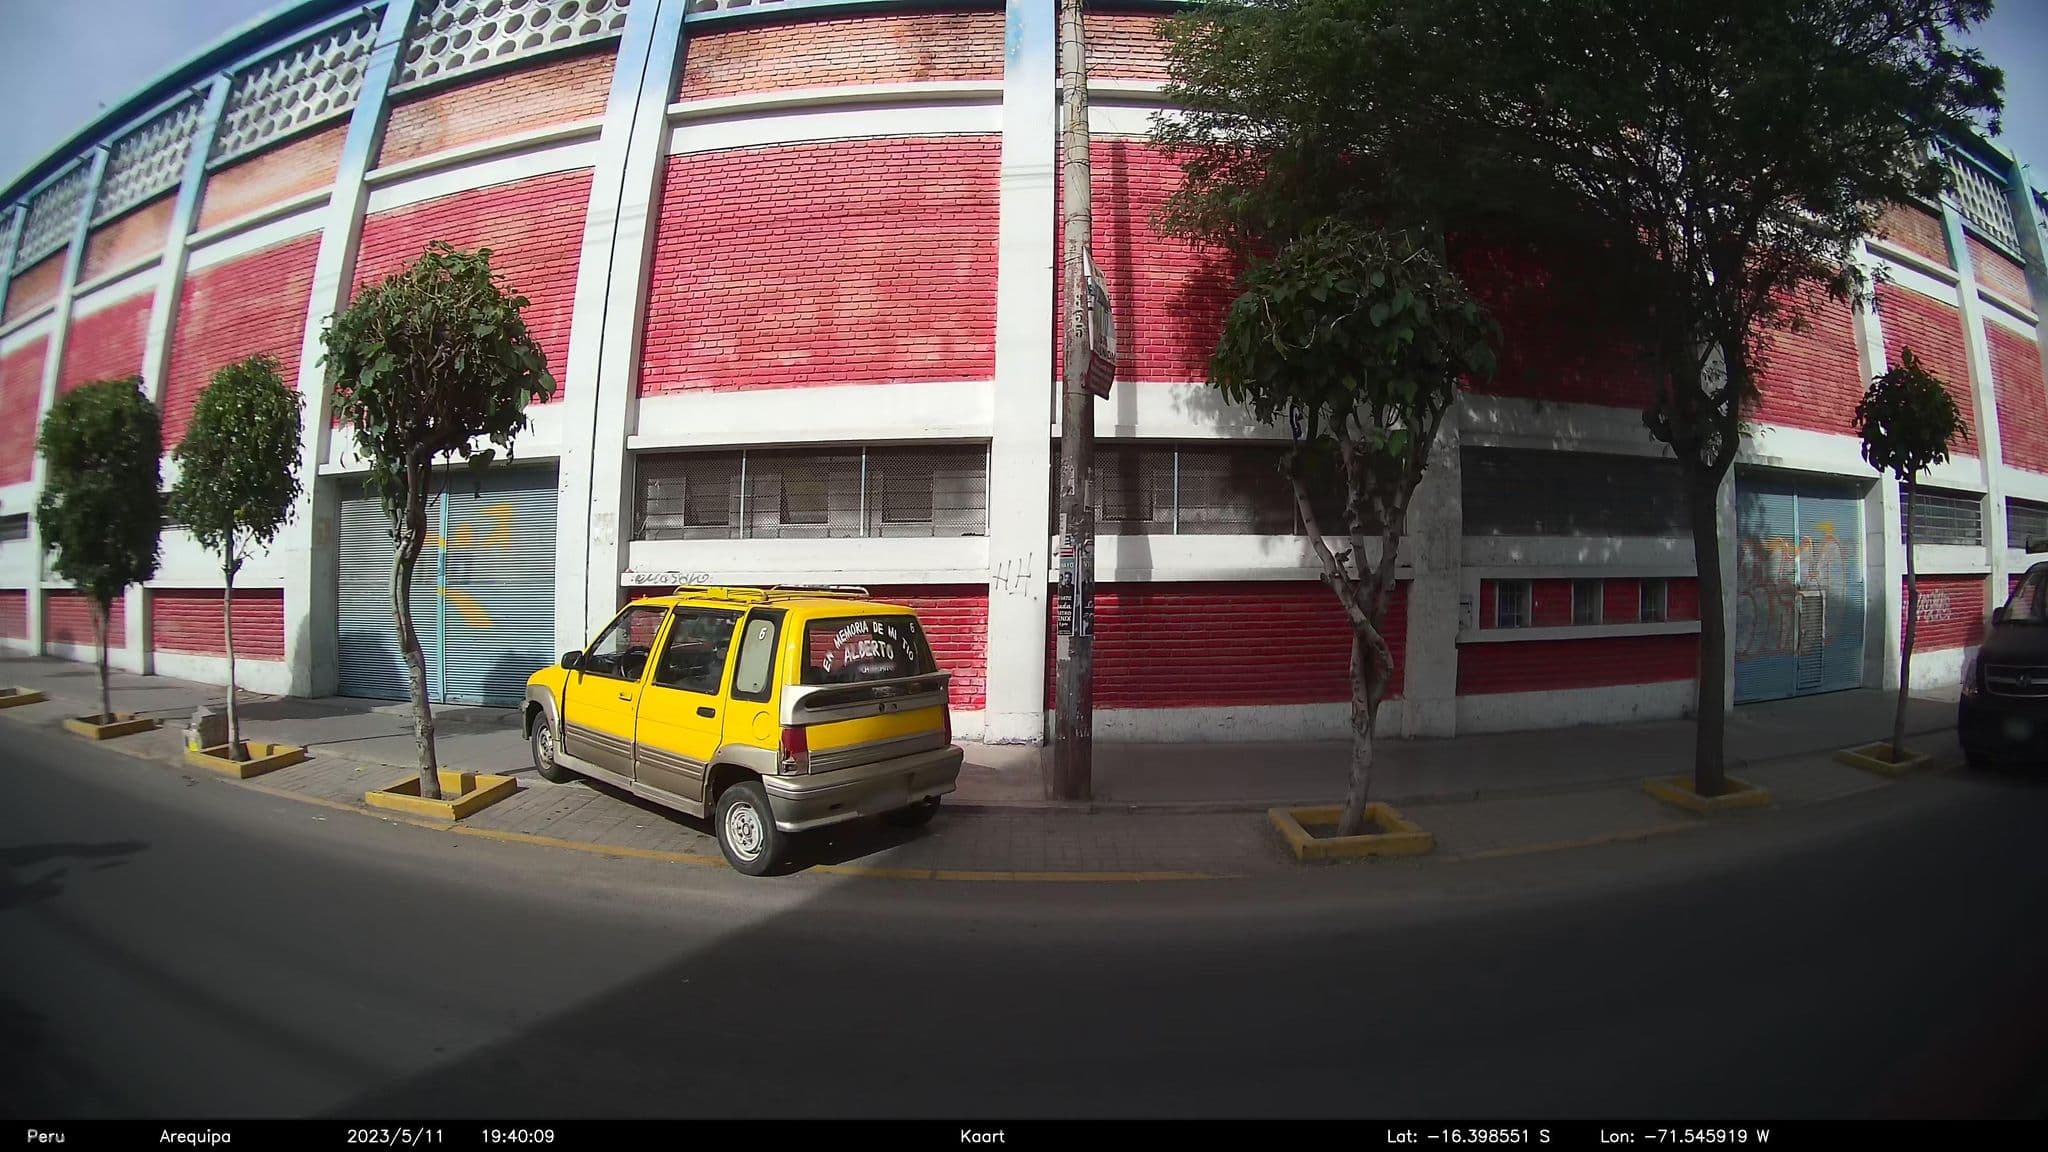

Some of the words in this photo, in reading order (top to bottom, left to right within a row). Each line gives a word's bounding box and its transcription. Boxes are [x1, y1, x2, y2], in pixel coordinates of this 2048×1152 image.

[759, 627, 767, 640] 6
[909, 622, 915, 633] 6
[833, 620, 869, 650] MEMORIA
[872, 621, 884, 635] DE
[887, 625, 897, 640] MI
[902, 637, 914, 661] TIO
[844, 640, 894, 665] ALBERTO
